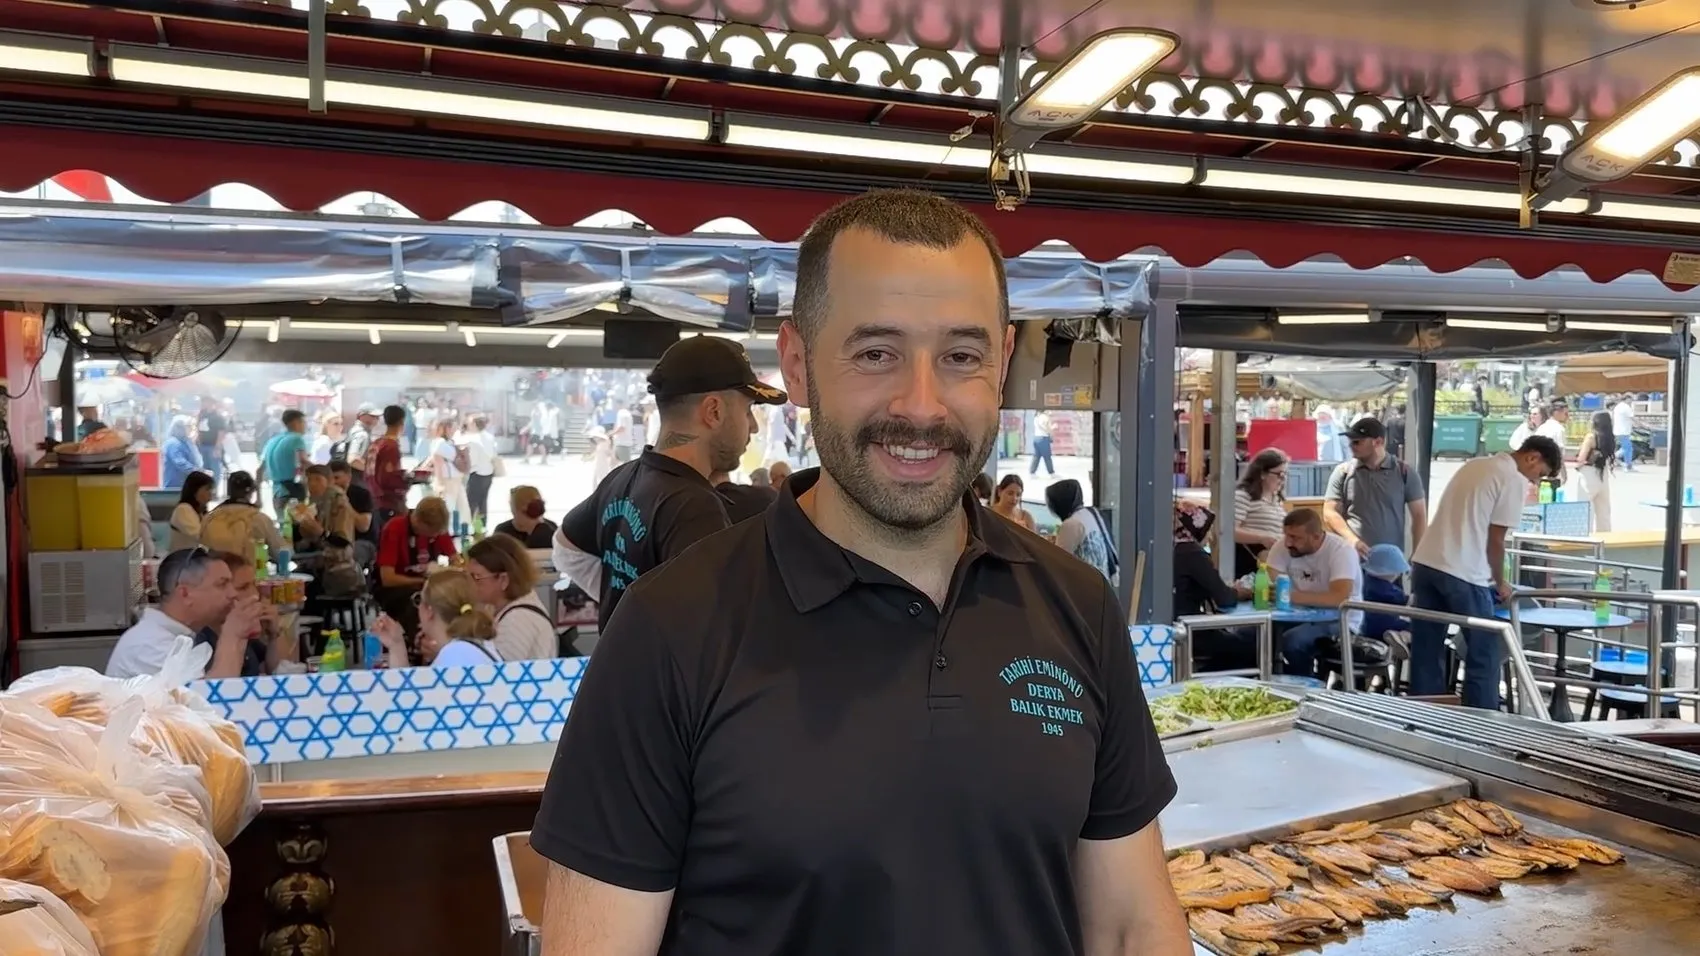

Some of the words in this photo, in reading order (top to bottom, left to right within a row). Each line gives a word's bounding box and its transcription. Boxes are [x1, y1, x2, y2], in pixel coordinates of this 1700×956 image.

[1027, 110, 1078, 119] ACK
[1580, 155, 1624, 172] ACK
[999, 655, 1035, 685] TARİHİ
[1027, 683, 1065, 702] DERYA
[1010, 698, 1046, 717] BALIK
[1047, 705, 1084, 724] EKMEK
[1041, 722, 1064, 736] 1945
